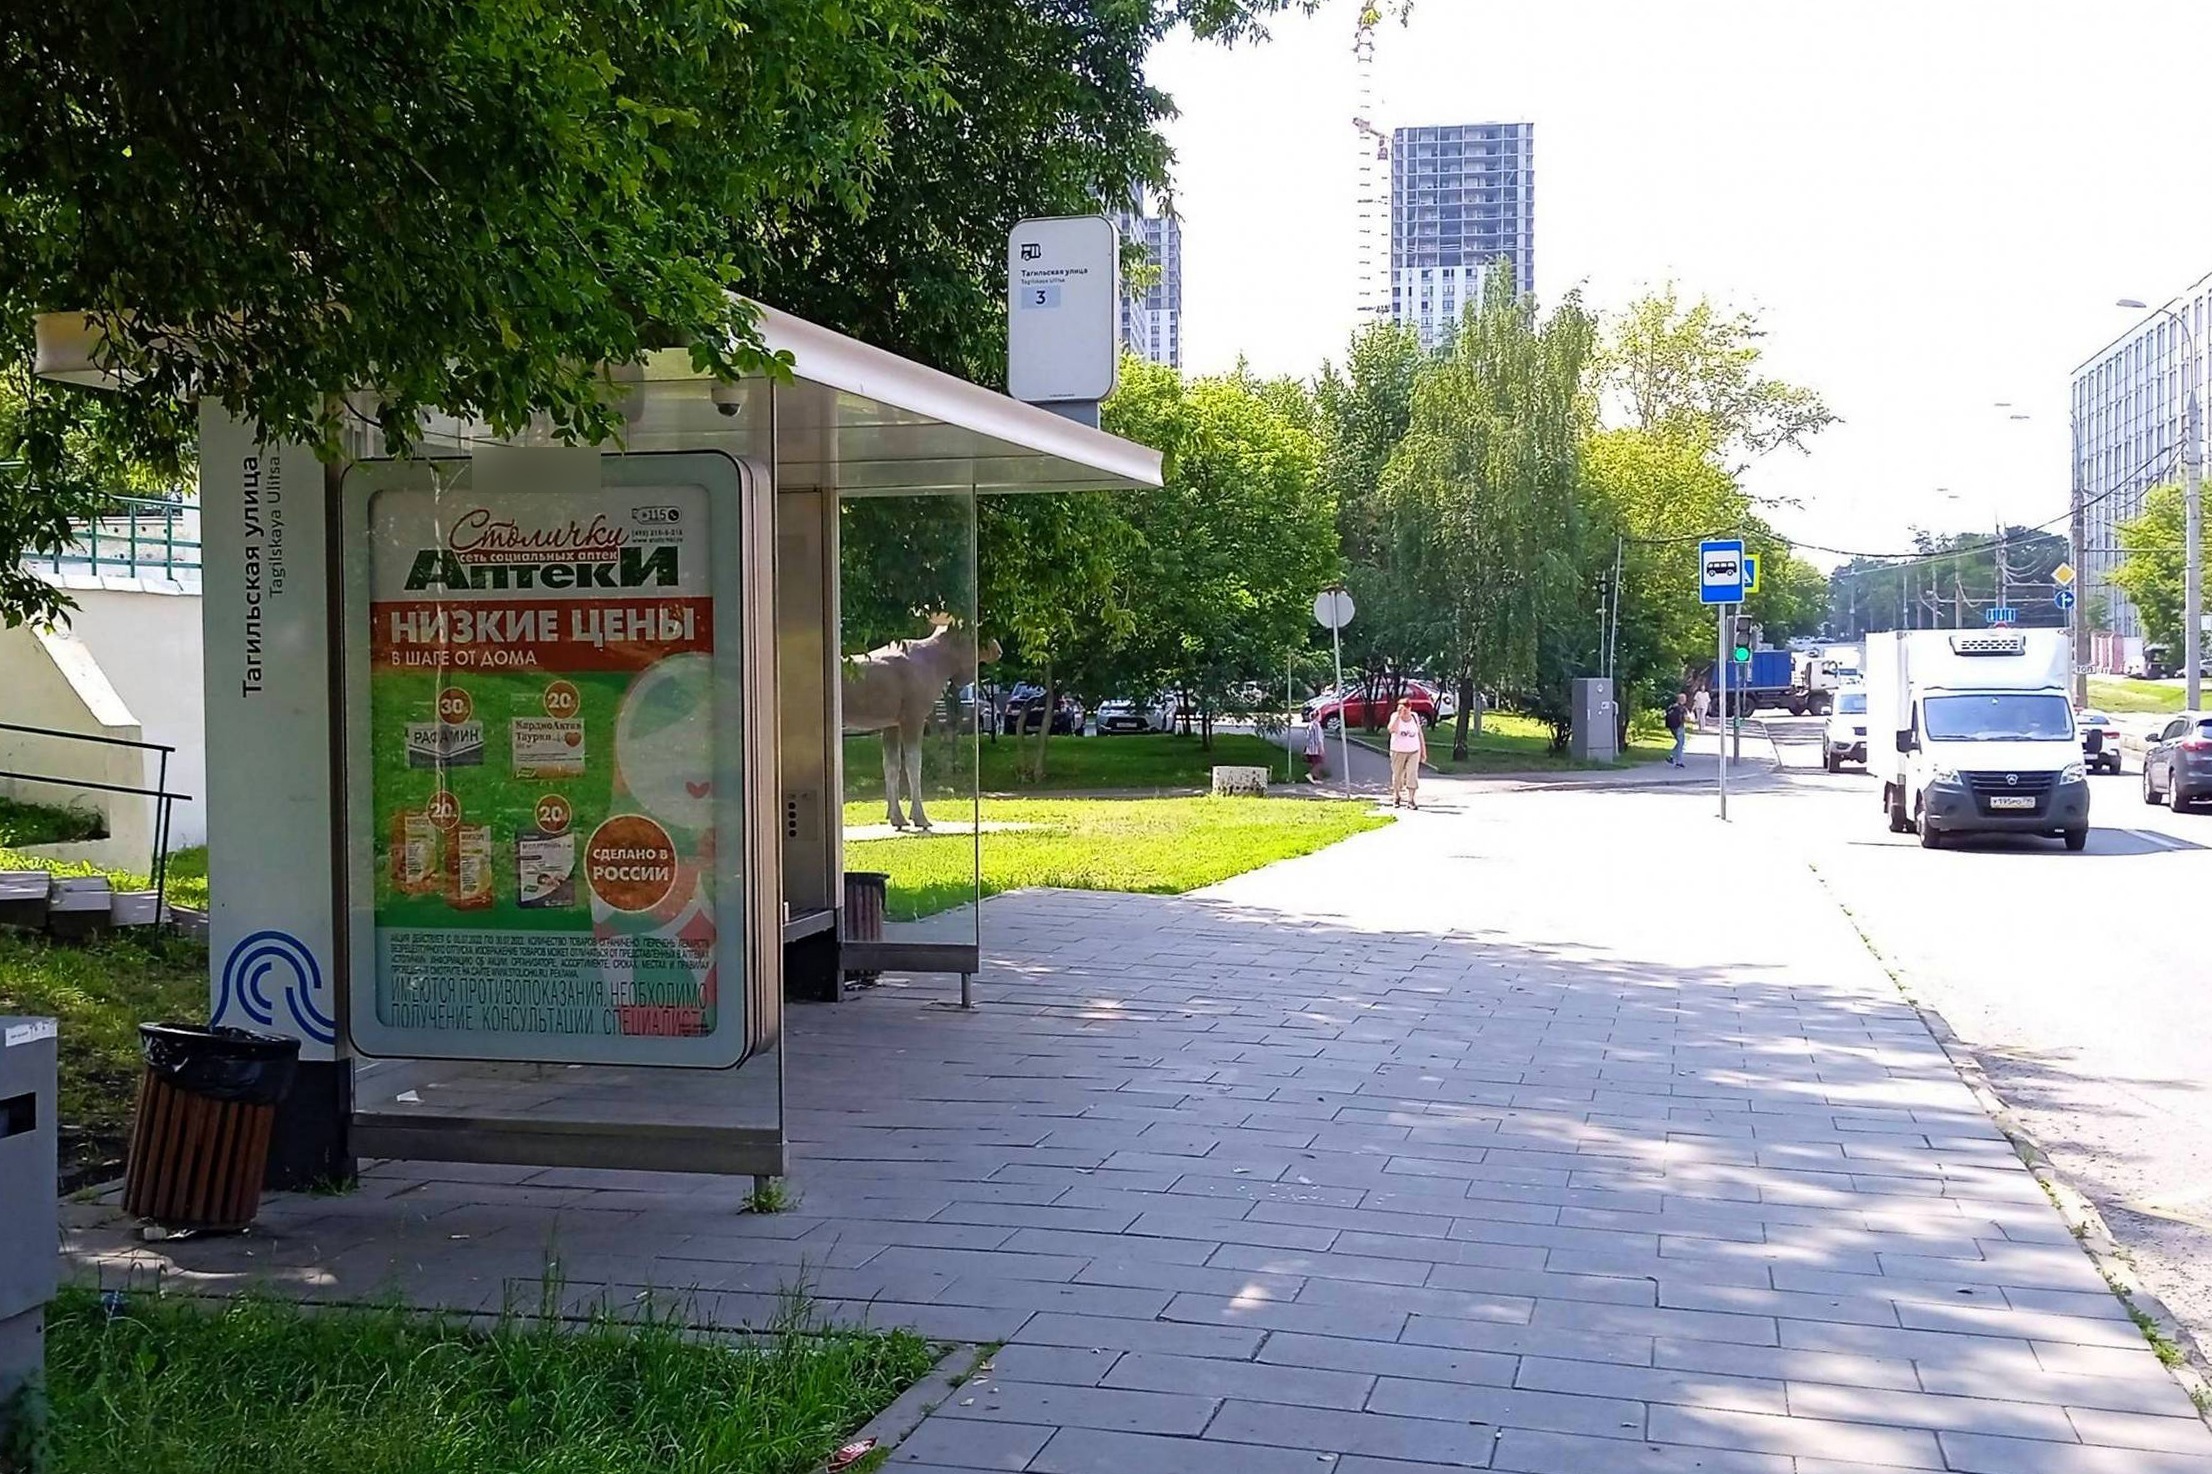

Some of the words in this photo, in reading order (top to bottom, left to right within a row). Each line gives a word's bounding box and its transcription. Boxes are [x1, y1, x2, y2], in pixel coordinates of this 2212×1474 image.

[1035, 290, 1046, 305] 3
[266, 456, 281, 503] Ulitsa
[243, 457, 264, 537] улица
[448, 508, 630, 552] Столички
[267, 510, 285, 598] Tagilskaya
[459, 551, 487, 564] сеть
[490, 550, 575, 564] социальных
[577, 550, 619, 562] аптек
[243, 546, 262, 698] Тагильская
[391, 608, 558, 644] НИЗКИЕ
[571, 606, 695, 650] ЦЕНЫ
[392, 650, 401, 666] В
[406, 650, 450, 667] ШАГЕ
[454, 650, 475, 667] ОТ
[480, 650, 538, 668] ДОМА
[592, 848, 655, 861] СДЕЛАНО
[658, 849, 668, 860] В
[592, 867, 669, 882] РОССИИ
[391, 977, 455, 1004] ИМЕЮТСЯ
[611, 982, 707, 1009] НЕОБХОДИМО
[391, 1003, 473, 1031] ПОЛУЧЕНИЕ
[482, 1005, 594, 1034] КОНСУЛЬТАЦИИ
